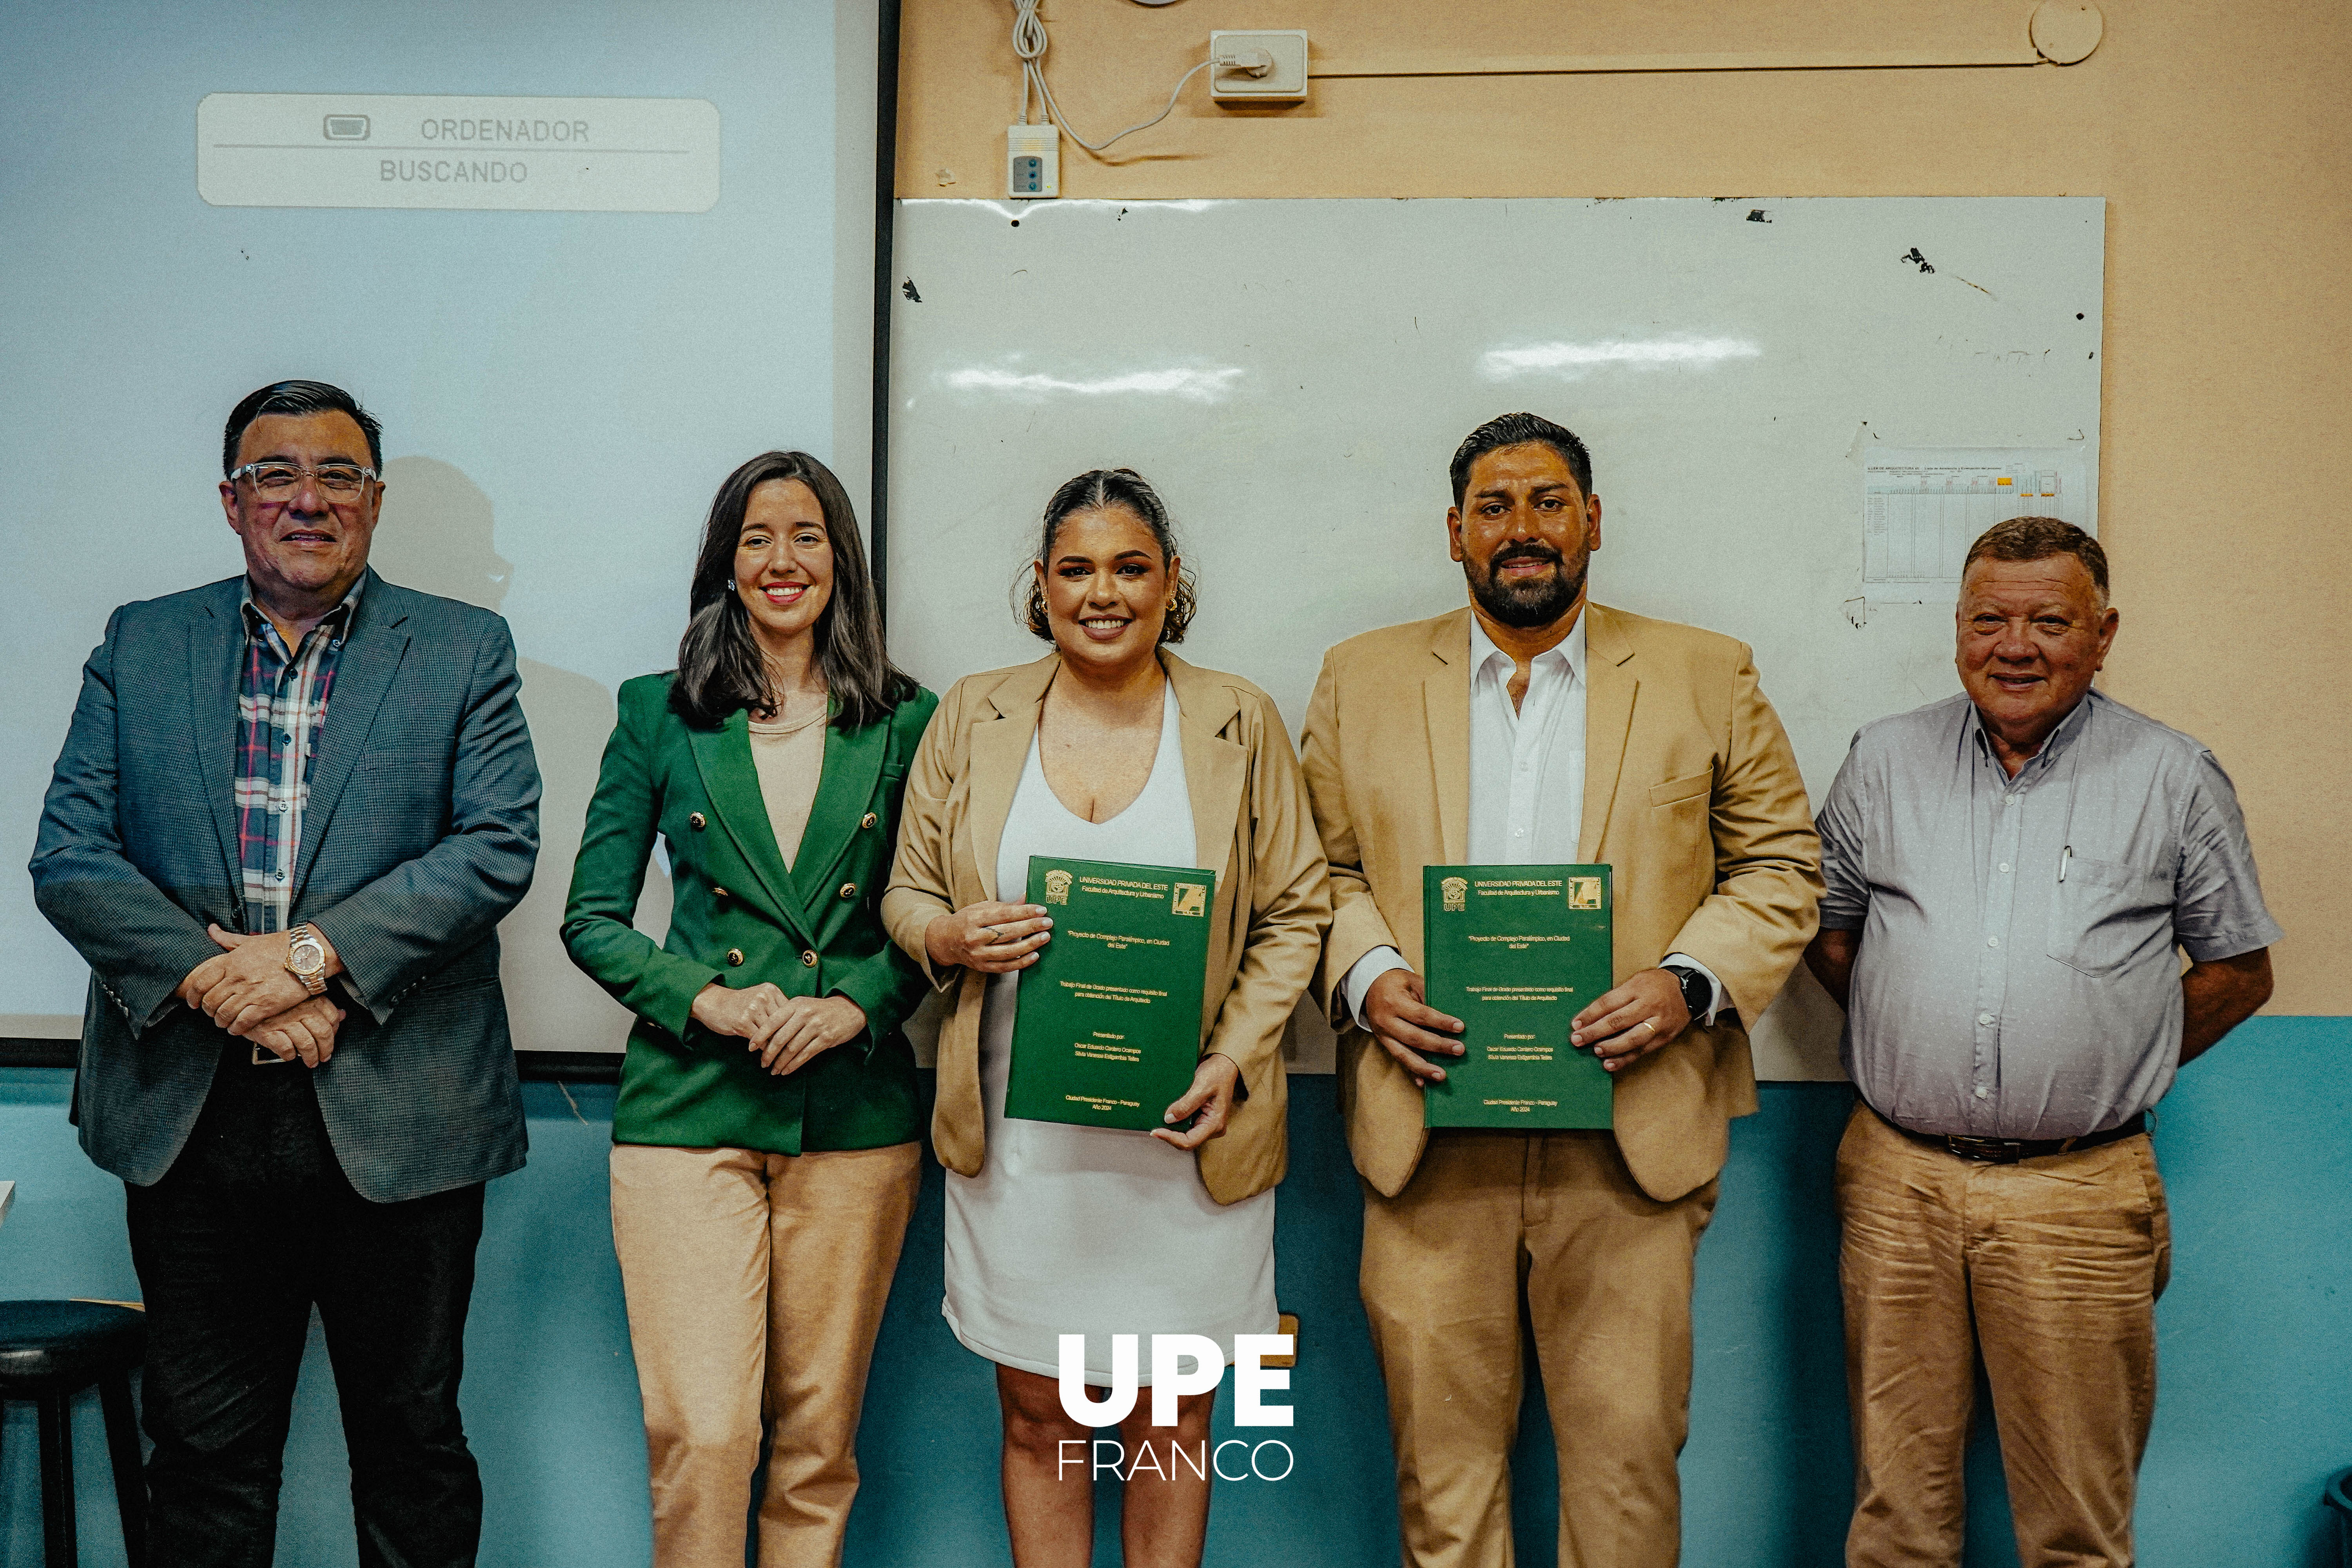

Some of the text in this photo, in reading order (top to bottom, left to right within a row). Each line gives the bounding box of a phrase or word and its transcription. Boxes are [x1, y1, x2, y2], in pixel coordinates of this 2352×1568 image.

[421, 118, 588, 142] ORDENADOR
[380, 160, 527, 183] BUSCANDO
[1079, 877, 1117, 886] UNIVERSIDAD
[1117, 880, 1141, 888] PRIVADA
[1046, 895, 1067, 905] UPE
[1444, 903, 1465, 912] UPE
[1096, 933, 1118, 942] Complejo
